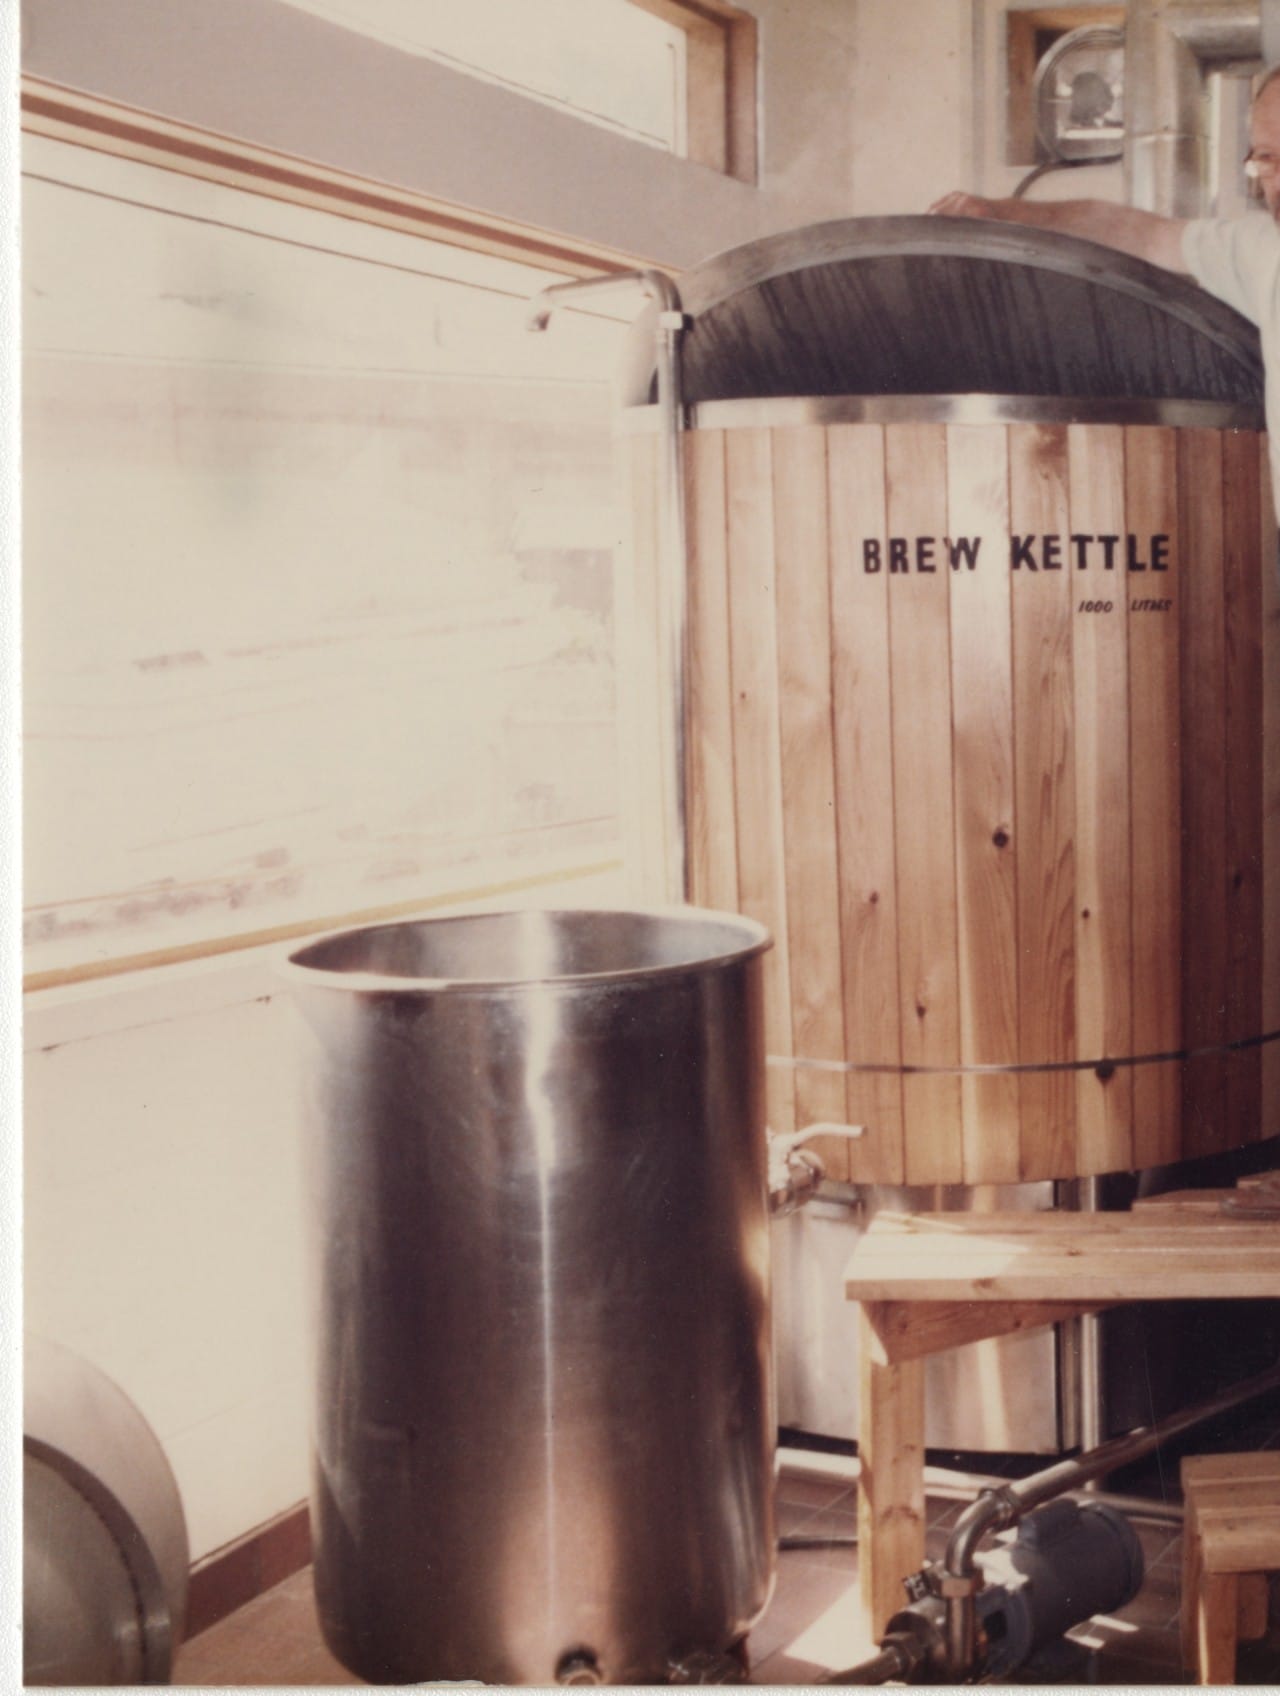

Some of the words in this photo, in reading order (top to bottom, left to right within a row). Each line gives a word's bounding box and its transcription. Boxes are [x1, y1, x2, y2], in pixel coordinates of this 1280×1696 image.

[862, 536, 982, 575] BREW
[1010, 533, 1170, 572] KETTLE
[1078, 600, 1114, 614] 1000
